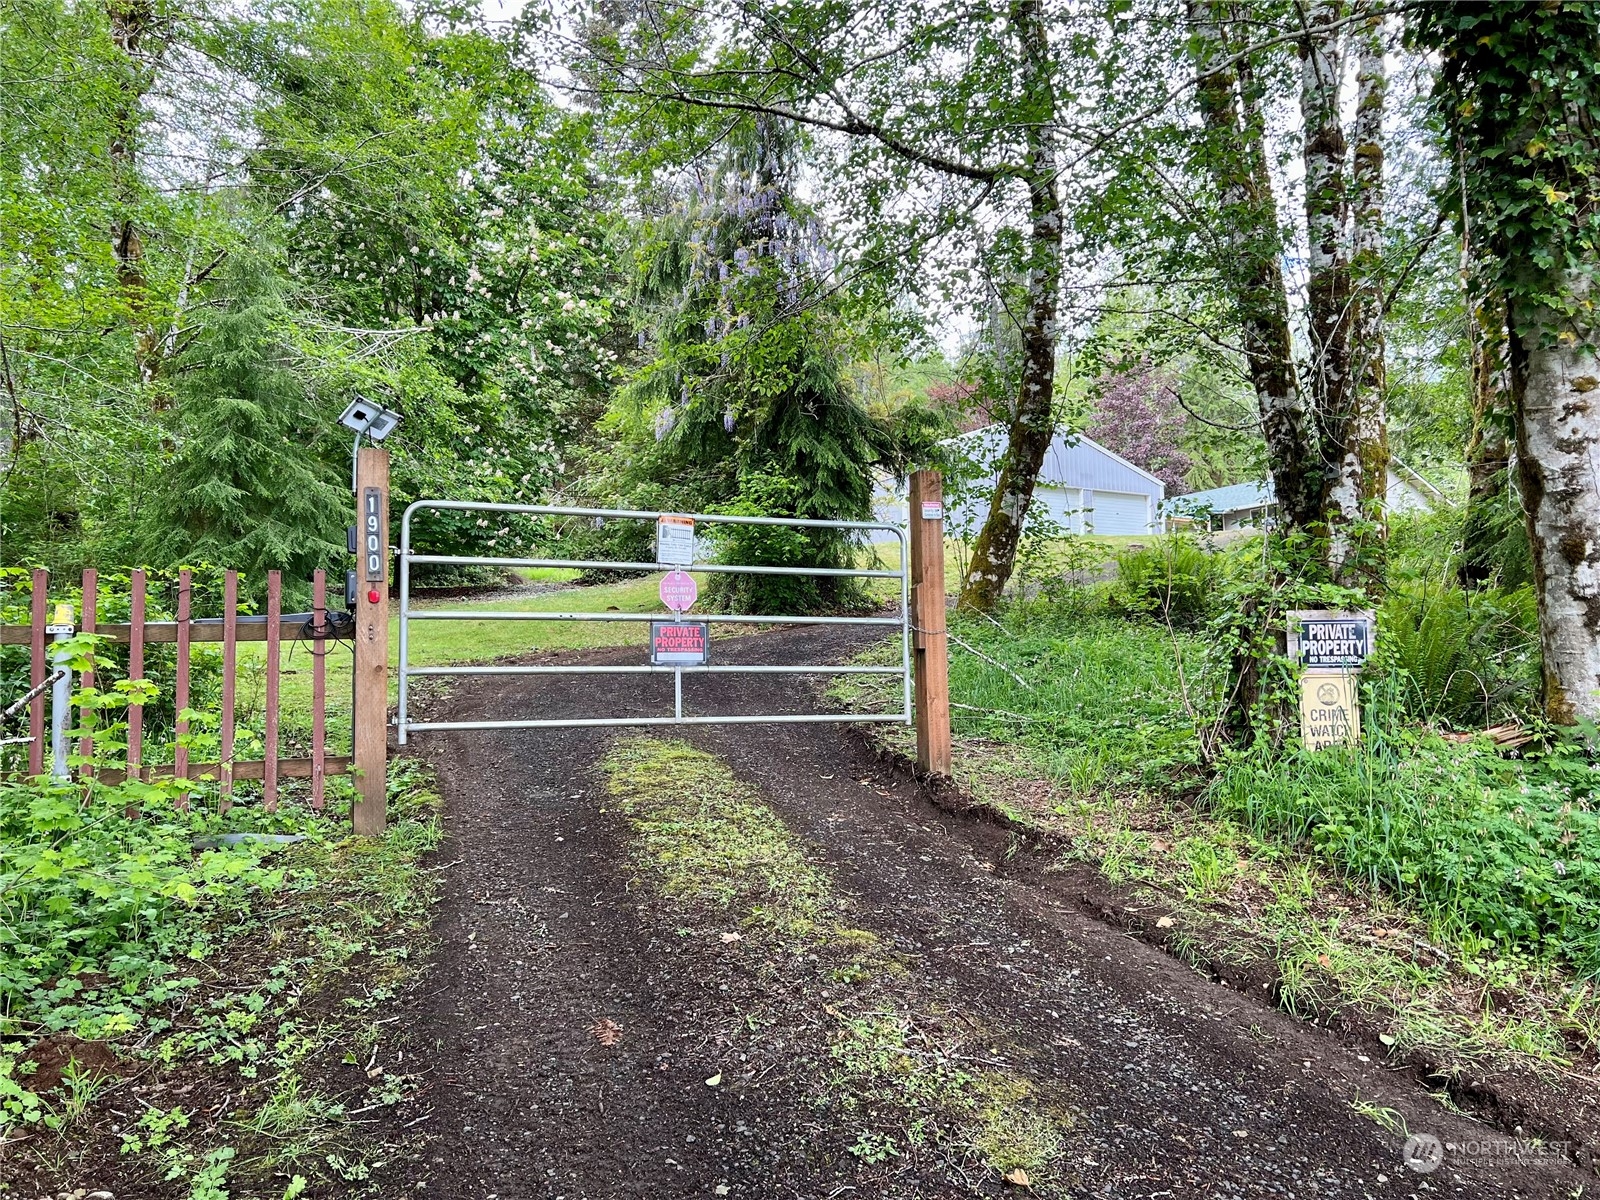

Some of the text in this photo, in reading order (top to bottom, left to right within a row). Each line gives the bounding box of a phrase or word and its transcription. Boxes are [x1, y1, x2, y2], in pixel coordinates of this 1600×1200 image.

[368, 497, 379, 570] 1900
[660, 627, 700, 637] PRIVATE
[1309, 624, 1356, 640] PRIVATE
[655, 637, 704, 647] PROPERTY
[1303, 640, 1363, 655] PROPERTY
[1310, 709, 1349, 721] CRIME
